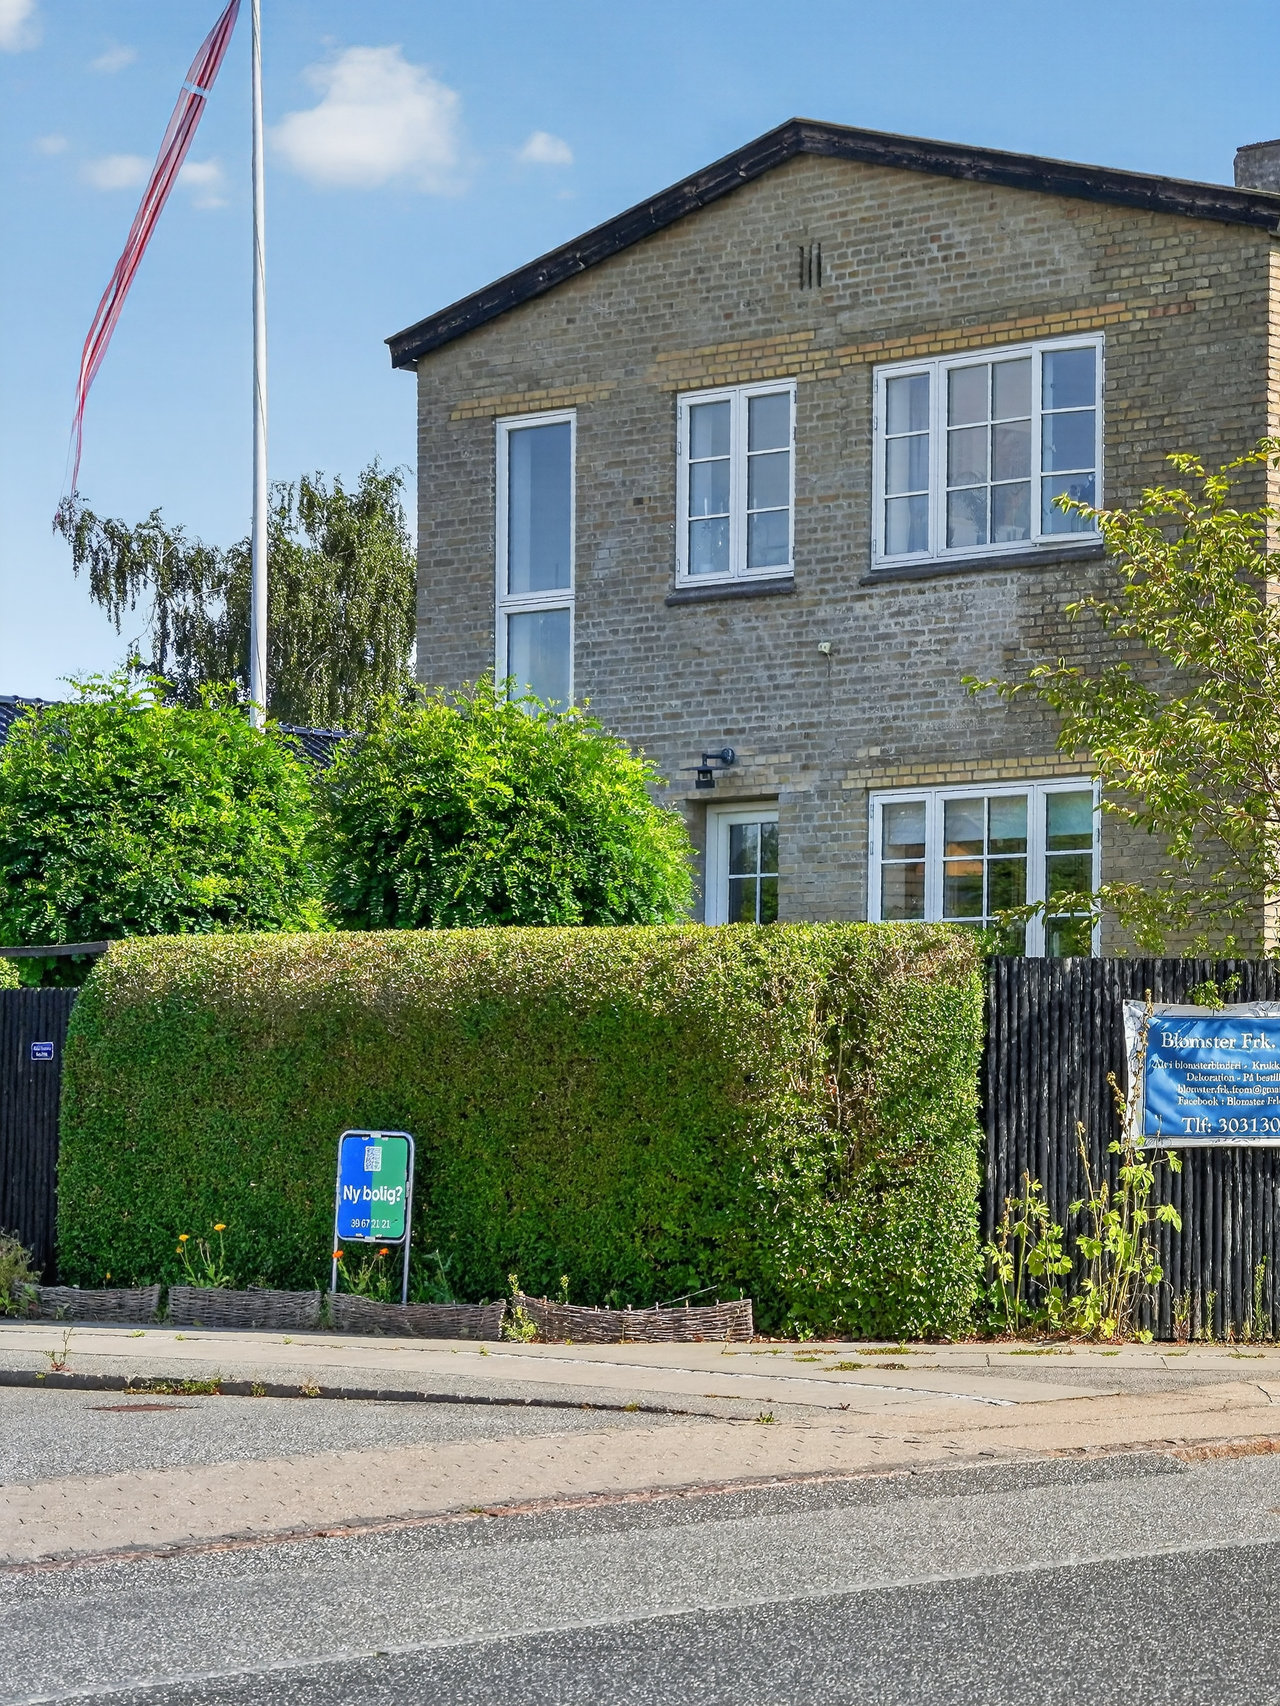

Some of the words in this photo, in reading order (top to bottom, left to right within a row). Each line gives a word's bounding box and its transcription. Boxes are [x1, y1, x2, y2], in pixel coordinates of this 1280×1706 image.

[1161, 1031, 1237, 1049] Blomster
[1241, 1032, 1275, 1049] Frk.
[1174, 1060, 1241, 1070] blomsterbinderi
[1186, 1072, 1235, 1082] Dekoration
[1177, 1096, 1219, 1106] Facebook
[1227, 1096, 1265, 1106] Blomster
[1181, 1117, 1212, 1133] Tlf:
[343, 1184, 361, 1204] Ny
[363, 1185, 403, 1205] bolig?
[351, 1218, 360, 1228] 39
[361, 1218, 370, 1228] 67
[371, 1219, 380, 1229] 21
[381, 1219, 391, 1229] 21
